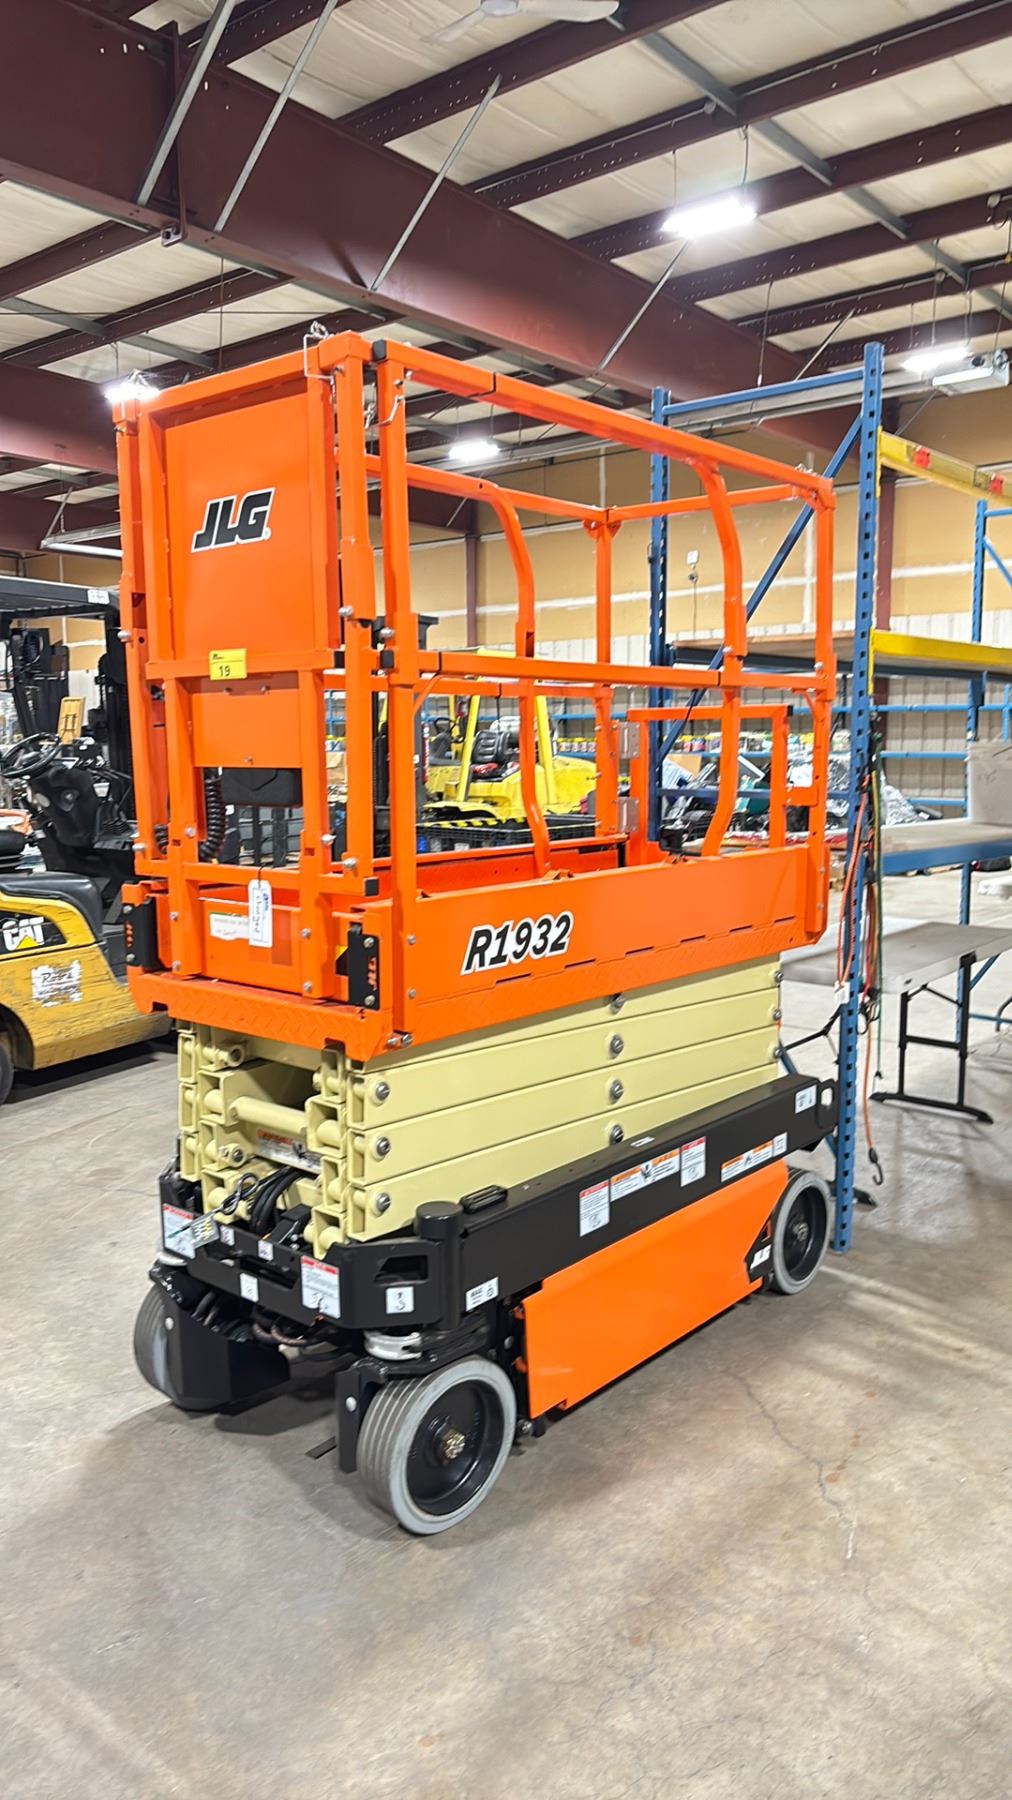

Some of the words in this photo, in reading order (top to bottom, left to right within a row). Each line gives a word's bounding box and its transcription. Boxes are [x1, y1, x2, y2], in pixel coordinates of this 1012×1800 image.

[191, 487, 275, 553] JLG
[219, 665, 230, 677] 19
[2, 917, 45, 951] CAT
[461, 911, 573, 975] R1932
